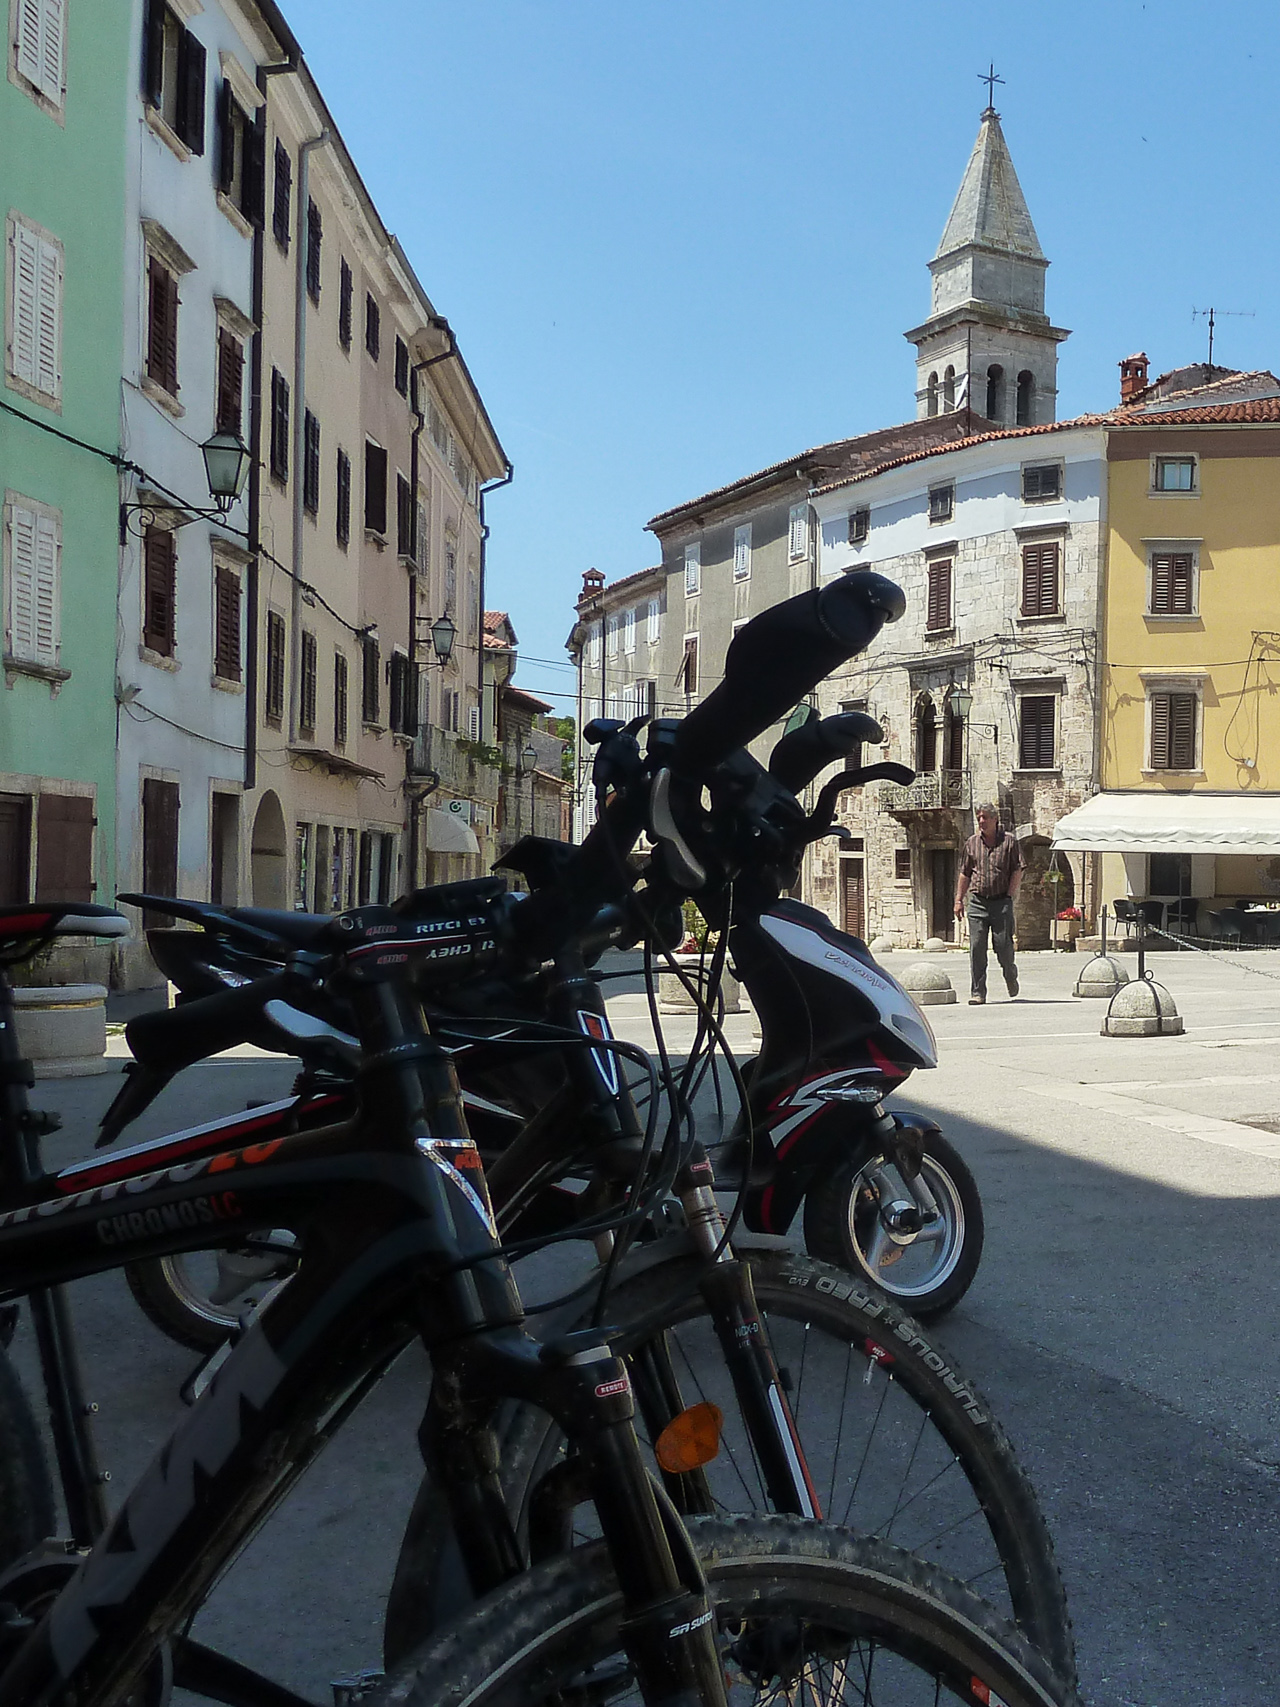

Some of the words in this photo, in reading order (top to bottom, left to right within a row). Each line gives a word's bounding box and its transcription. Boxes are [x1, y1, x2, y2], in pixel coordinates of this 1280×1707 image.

[425, 939, 496, 960] RICHEY
[815, 1276, 885, 1319] FRED
[892, 1322, 989, 1426] FURIOUS
